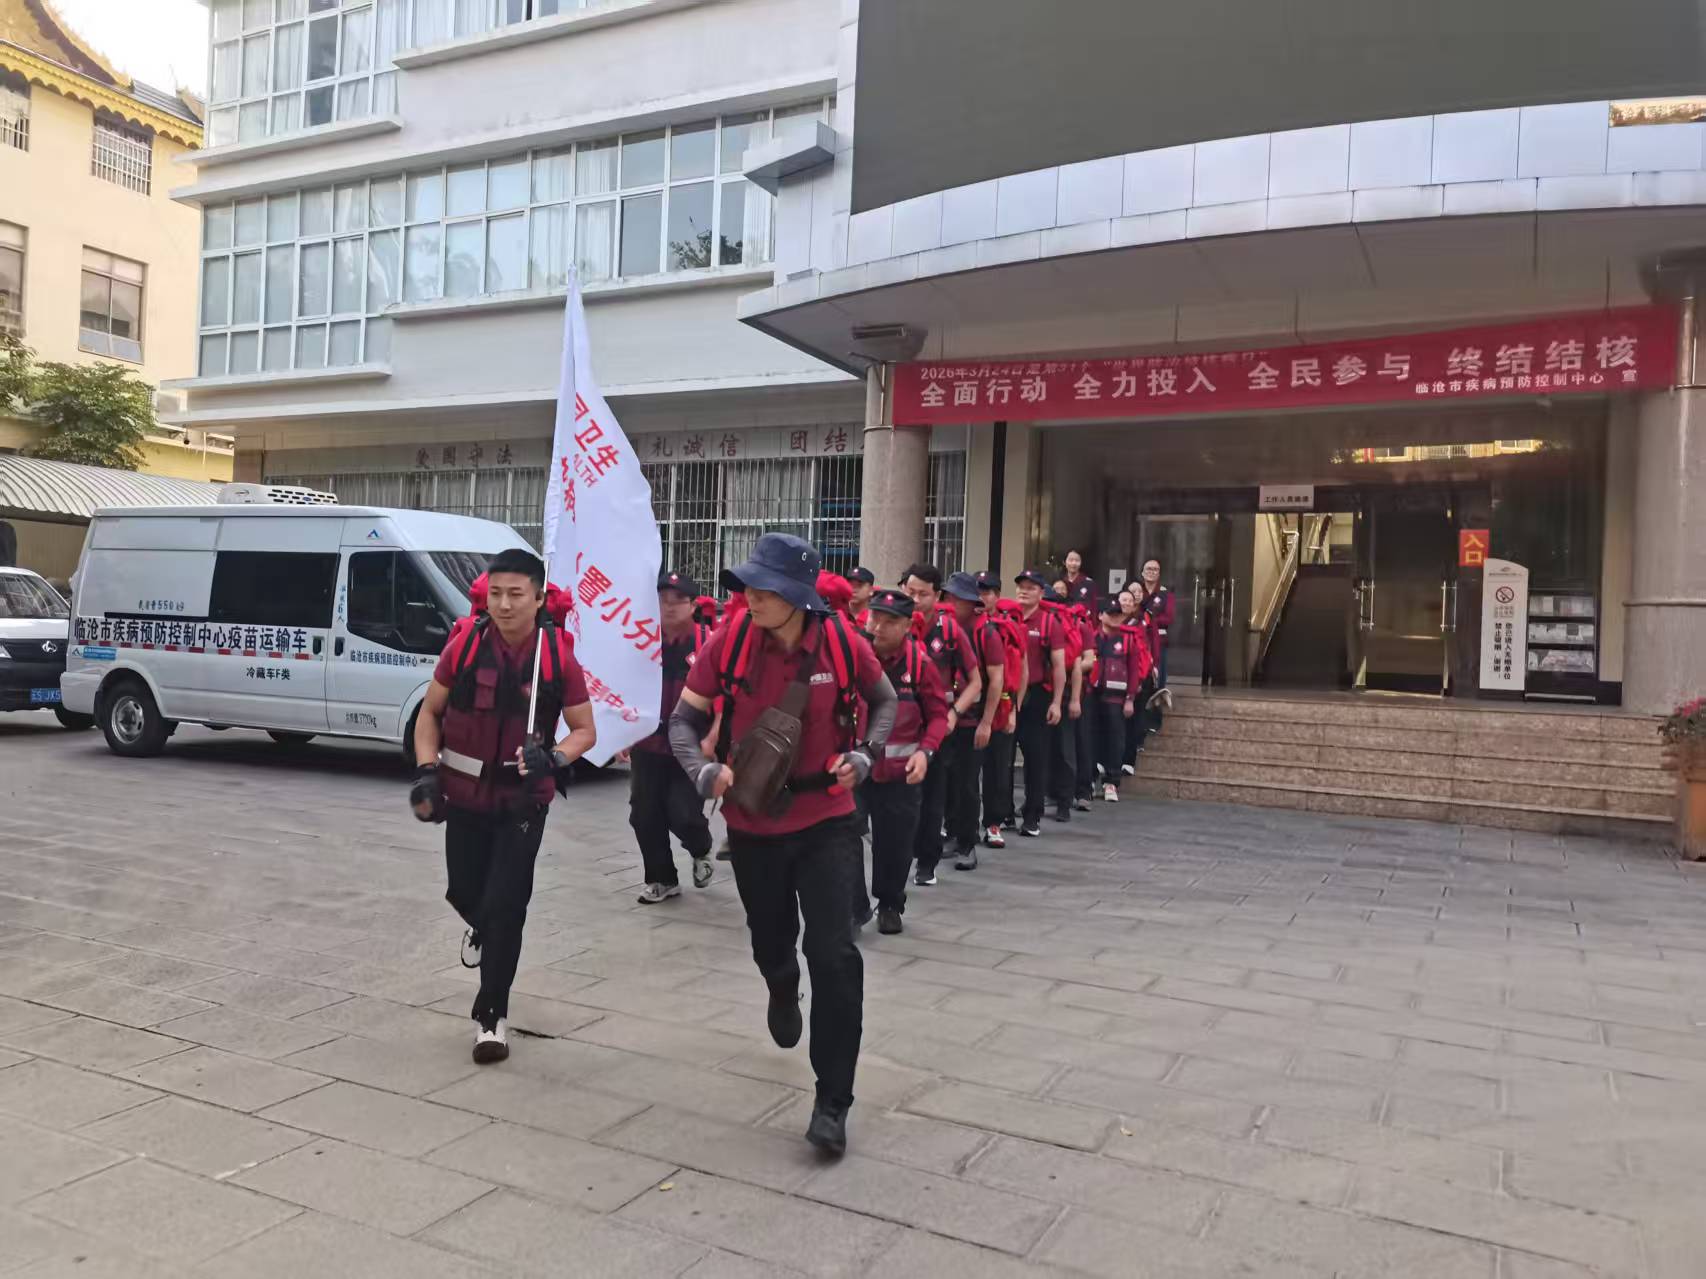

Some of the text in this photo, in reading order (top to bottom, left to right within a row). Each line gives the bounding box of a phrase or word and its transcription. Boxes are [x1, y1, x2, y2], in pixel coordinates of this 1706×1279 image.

[920, 375, 1048, 407] 全面行动
[1073, 367, 1217, 400] 全力投入
[1248, 353, 1411, 391] 全民参与
[1446, 336, 1638, 377] 终结结核
[1415, 369, 1638, 394] 临沧市疾病预防控制中心 宣
[635, 433, 739, 459] 礼诚信
[790, 427, 866, 454] 团结
[1464, 534, 1485, 564] 入口
[576, 552, 662, 667] 置小分
[74, 617, 308, 653] 临沧市疾病预防控制中心疫苗运输车
[246, 666, 290, 681] 冷藏车F类
[350, 649, 418, 668] 临沧市疾病预防控制中心
